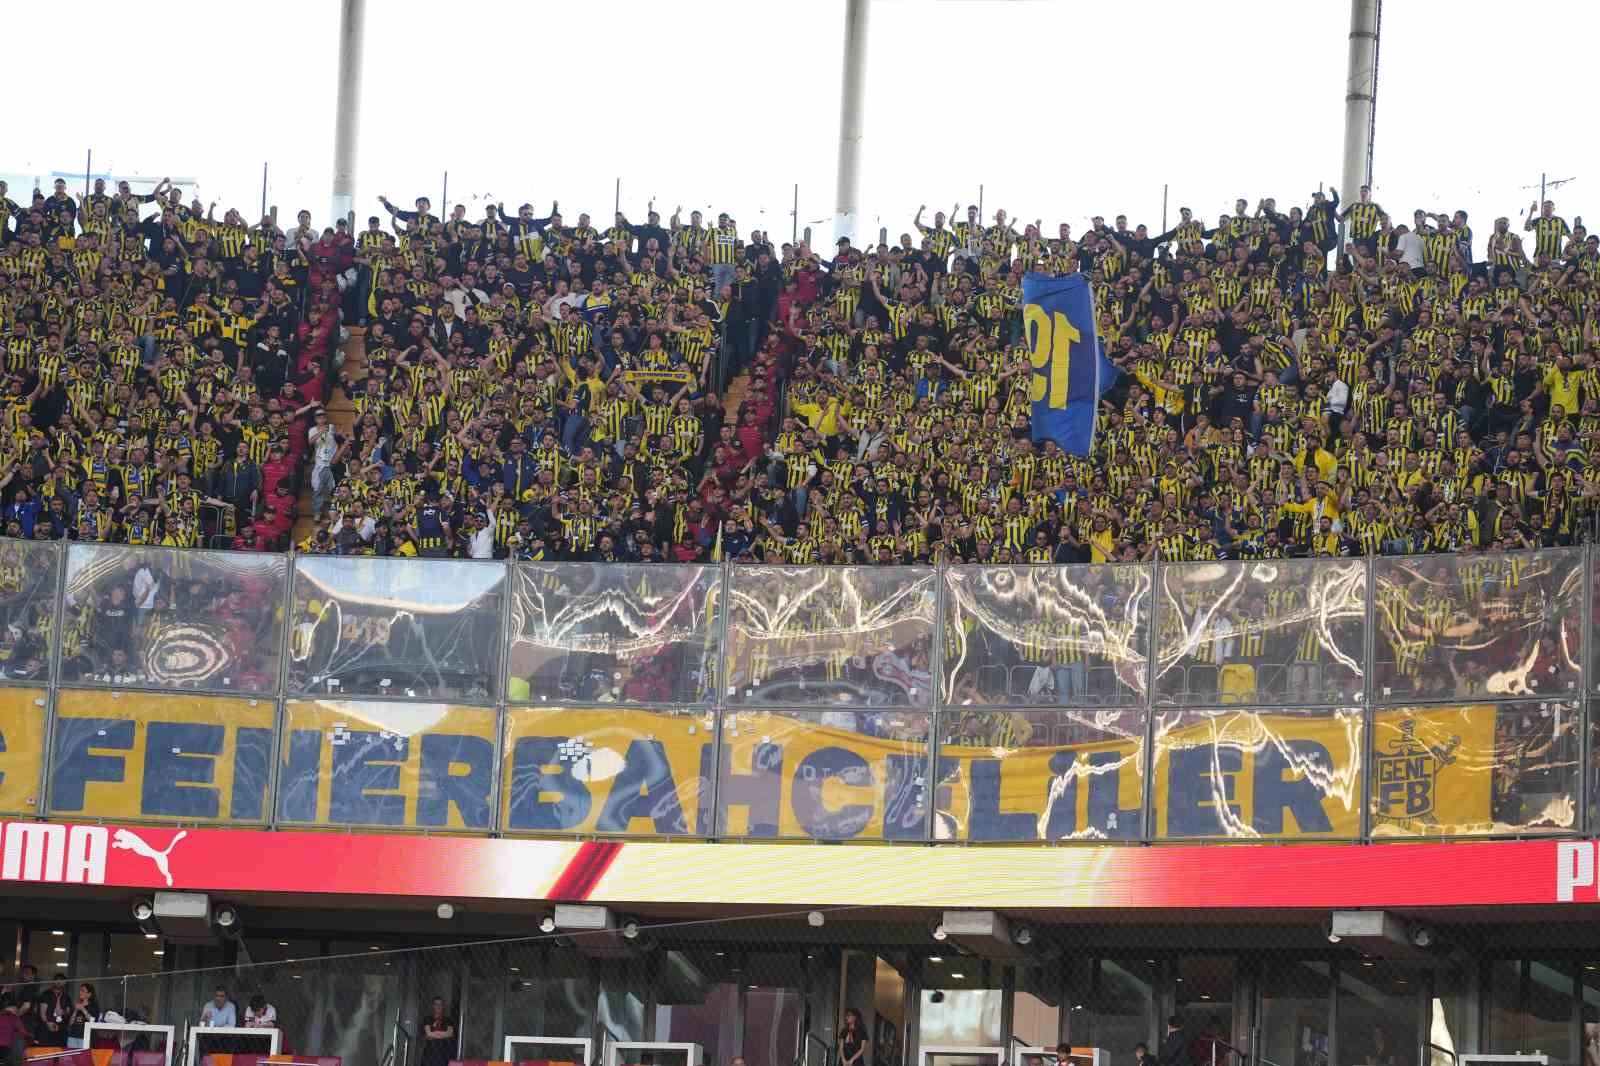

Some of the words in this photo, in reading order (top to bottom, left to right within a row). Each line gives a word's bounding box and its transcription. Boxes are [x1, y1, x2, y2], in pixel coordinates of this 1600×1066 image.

[1379, 781, 1431, 814] FB
[0, 822, 108, 884] MA
[1556, 841, 1600, 901] P
